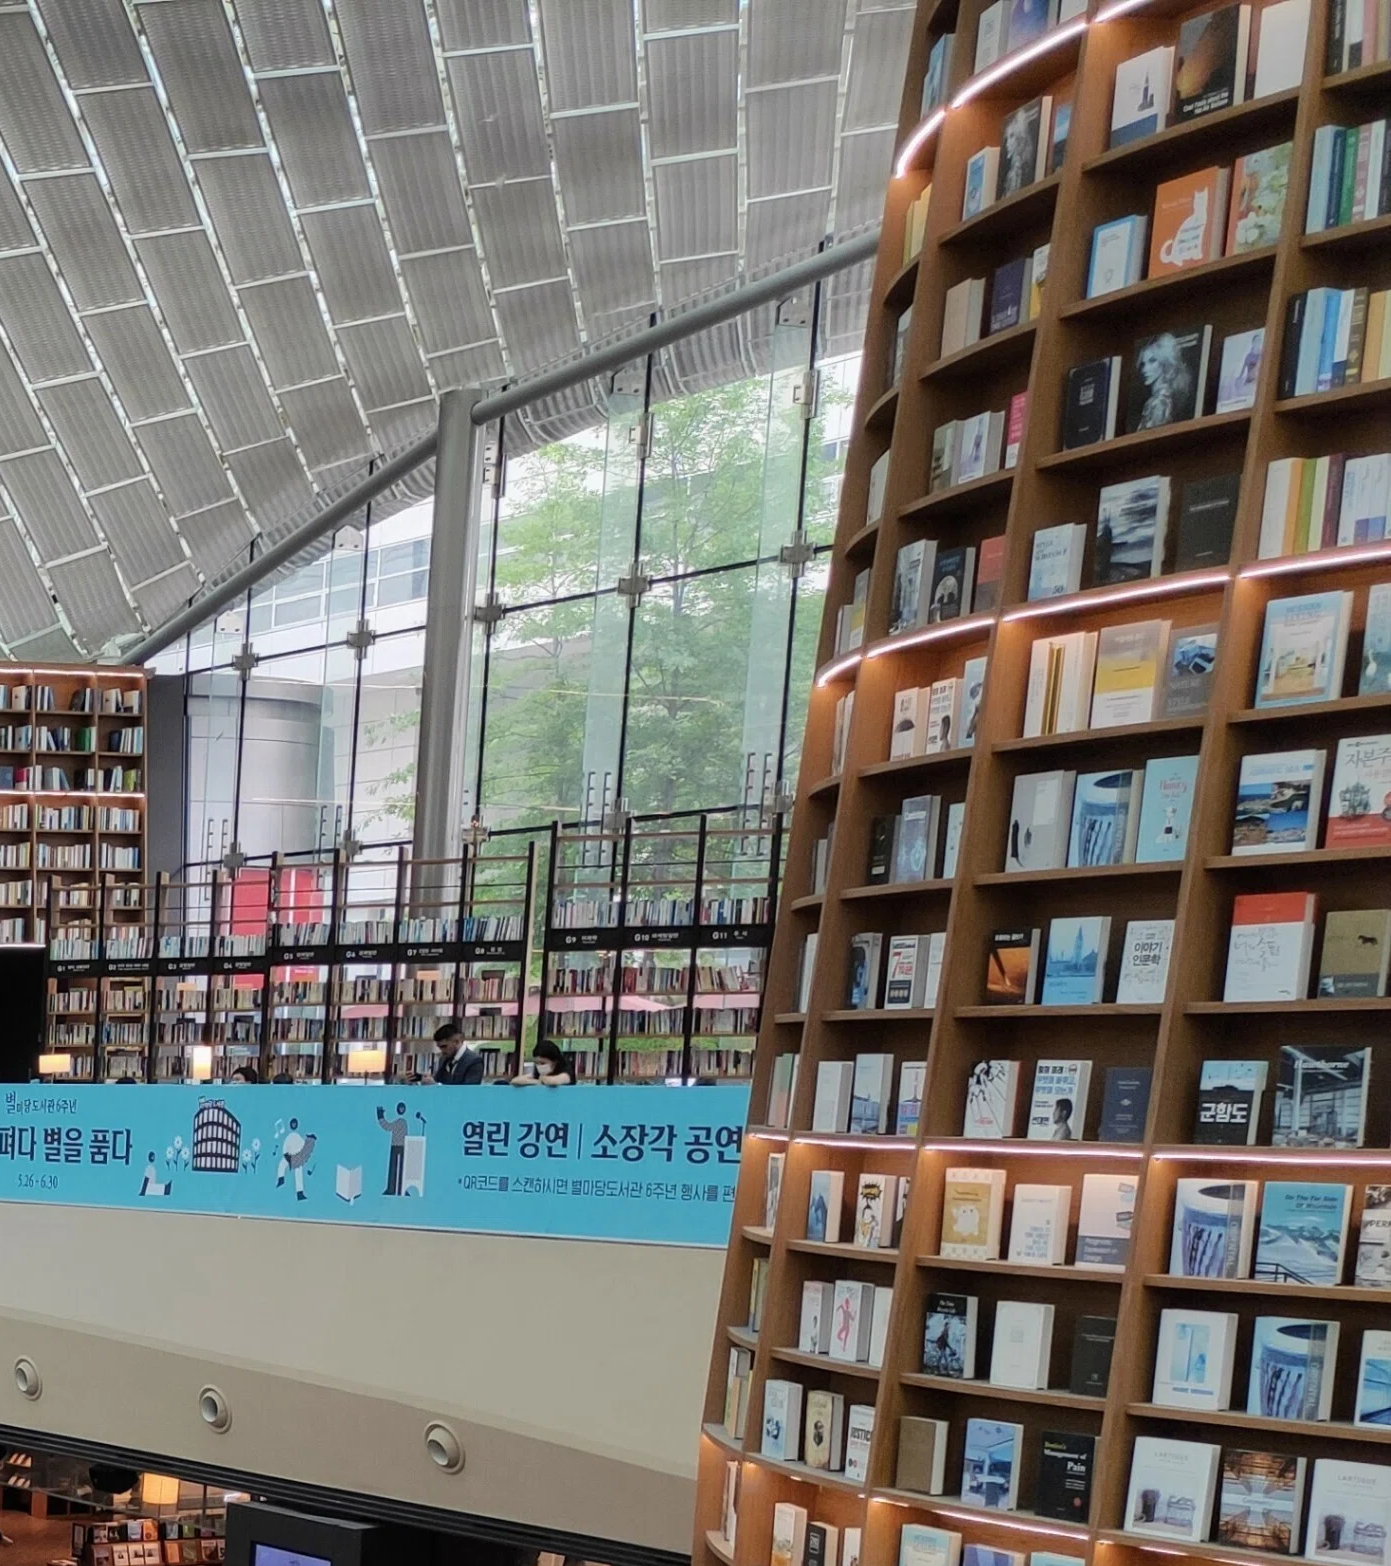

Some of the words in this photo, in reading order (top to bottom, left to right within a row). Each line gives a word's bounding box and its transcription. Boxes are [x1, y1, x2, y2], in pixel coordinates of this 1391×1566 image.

[1199, 1101, 1249, 1125] 군함도
[44, 1126, 84, 1165] 별을
[89, 1128, 133, 1166] 품다
[462, 1121, 509, 1158] 열린
[518, 1122, 569, 1160] 강연
[591, 1124, 677, 1162] 소장각
[684, 1125, 743, 1165] 공연
[512, 1176, 569, 1196] 스캔하시면
[571, 1179, 643, 1199] 별마당도서관
[646, 1183, 677, 1201] 6주년
[681, 1184, 718, 1203] 행사를
[1067, 1461, 1086, 1473] Pain
